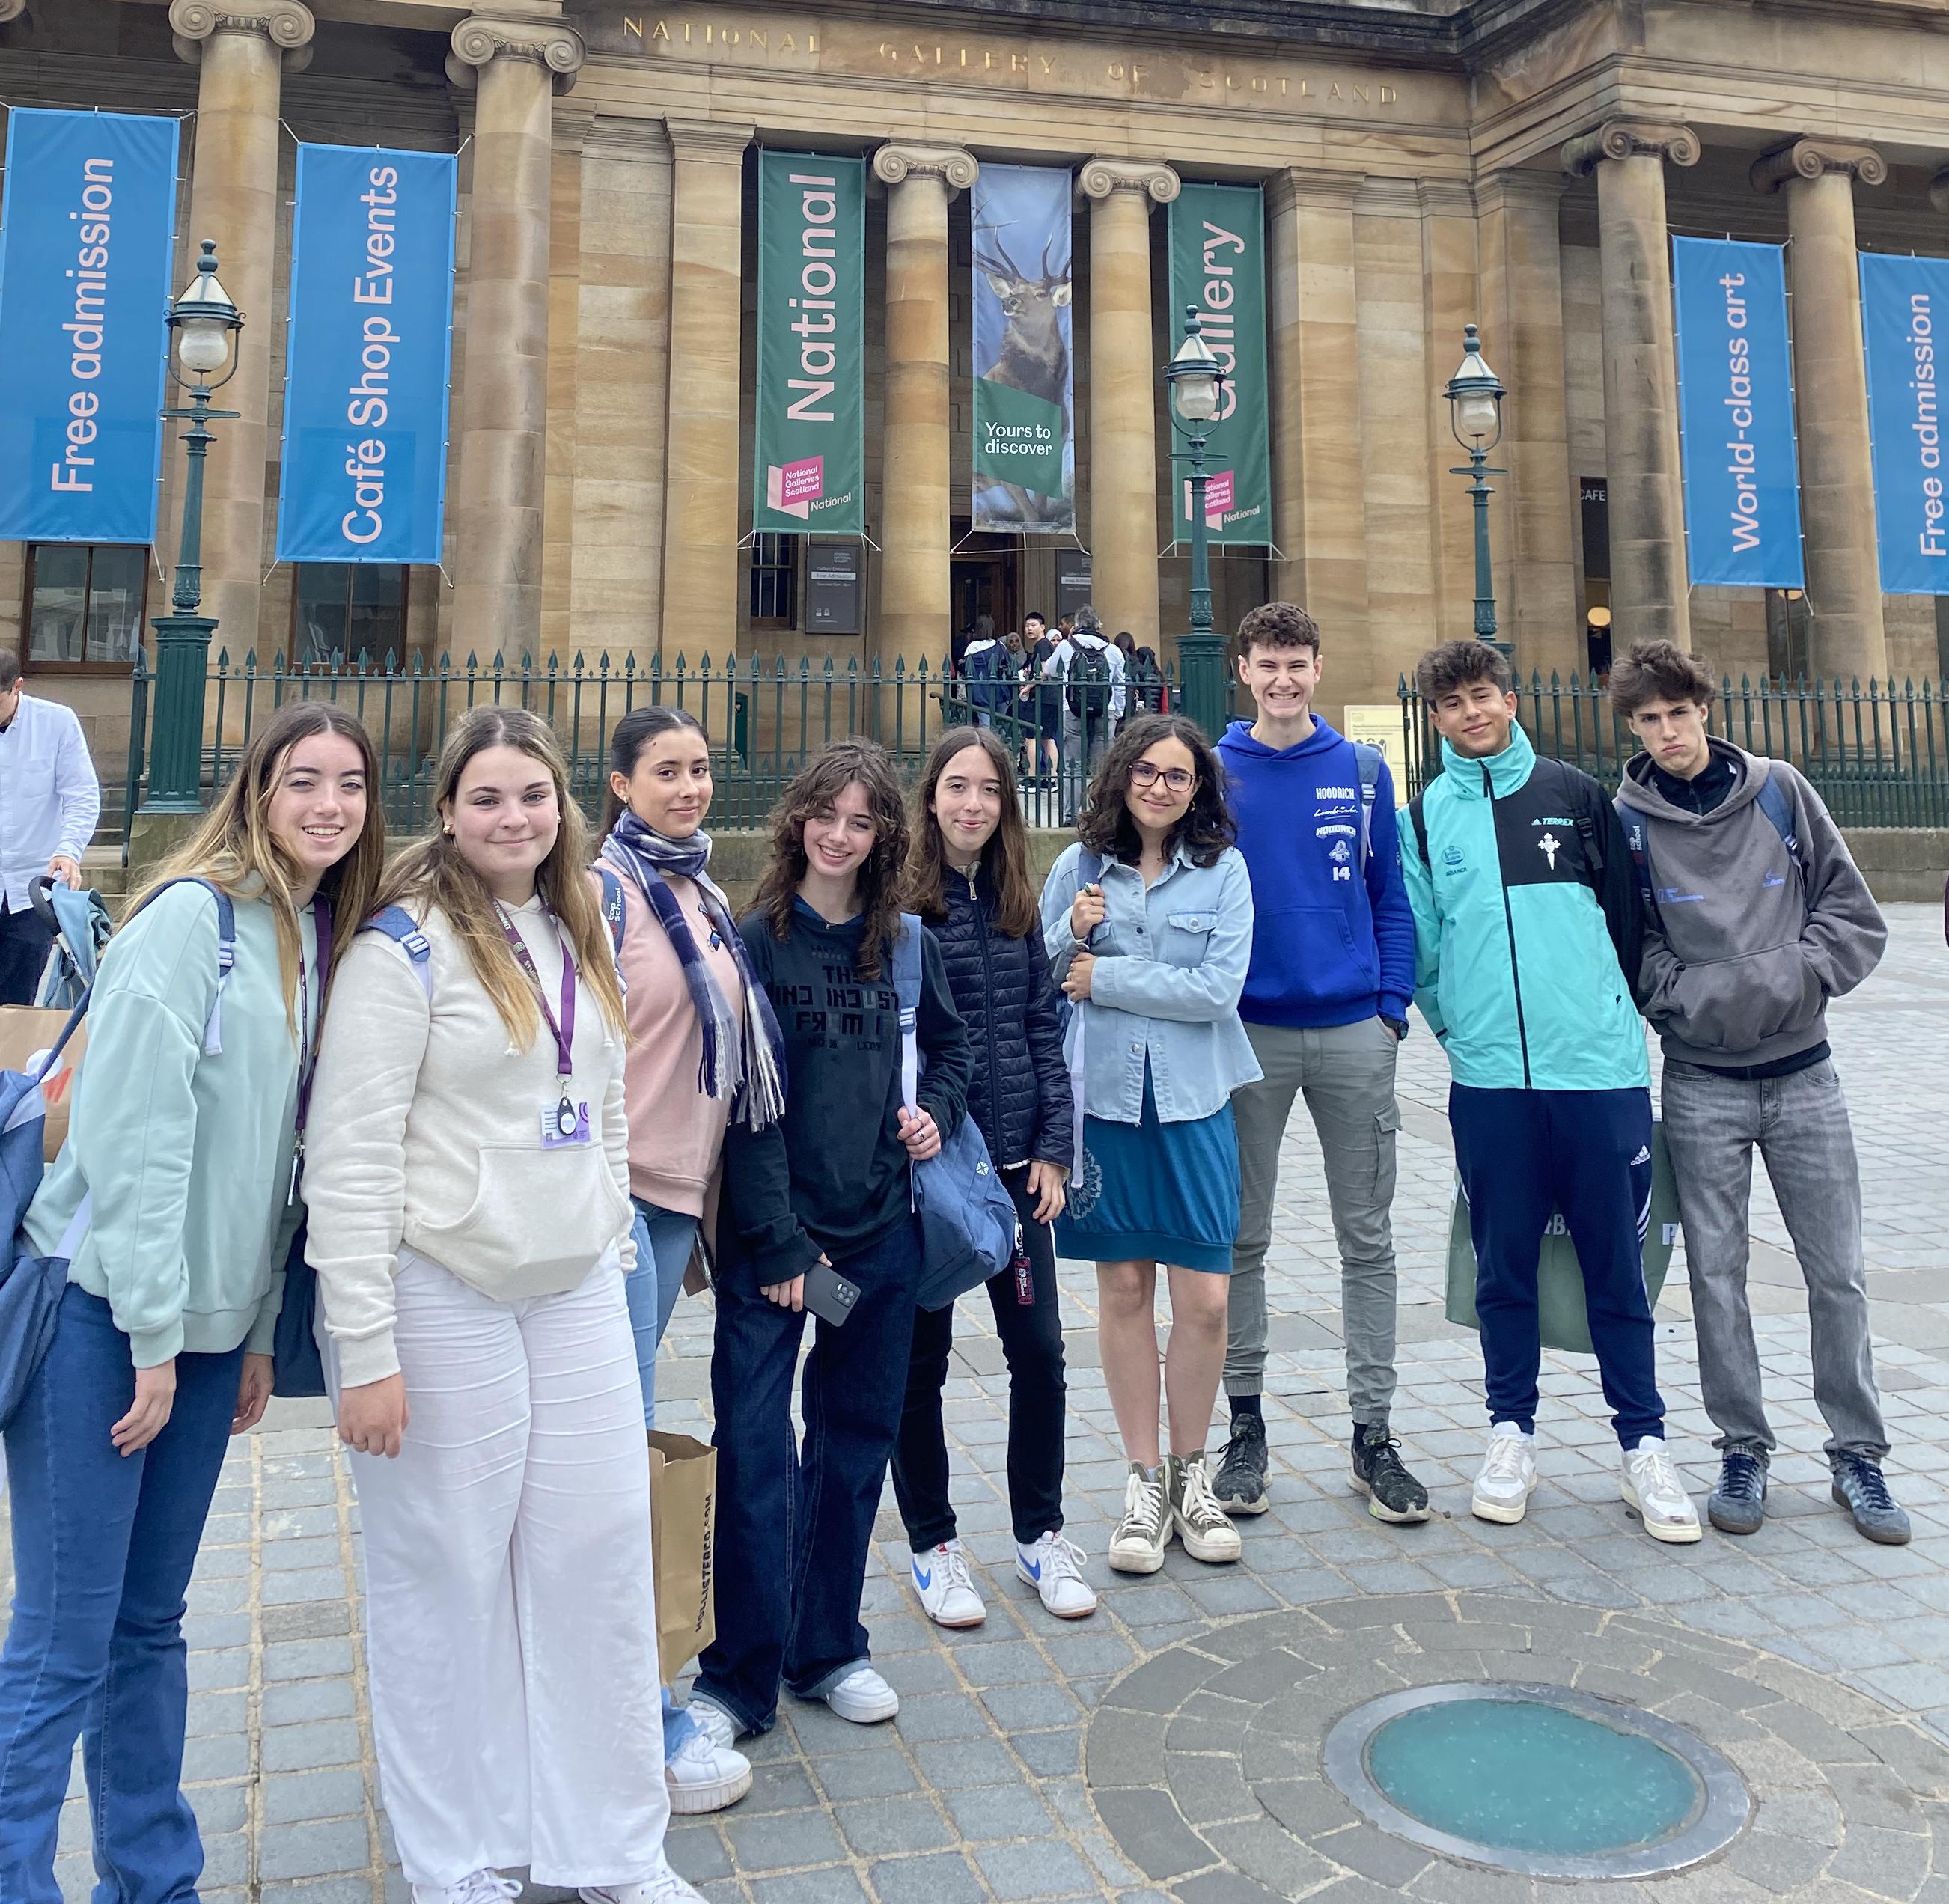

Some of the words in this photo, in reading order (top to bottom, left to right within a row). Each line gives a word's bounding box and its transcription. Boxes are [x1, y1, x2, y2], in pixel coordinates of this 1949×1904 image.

[623, 16, 820, 54] NATIONAL
[879, 42, 1055, 75] GALLERY
[1108, 61, 1148, 82] OF
[1199, 73, 1397, 104] SCOTLAND
[353, 166, 398, 305] Events
[62, 158, 114, 379] admission
[787, 174, 837, 421] National
[1719, 272, 1748, 329] art
[348, 316, 401, 427] Shop
[1906, 293, 1940, 469] admission
[985, 421, 1033, 438] Yours
[1035, 424, 1052, 439] to
[51, 391, 99, 492] Free
[985, 439, 1053, 456] discover
[1724, 338, 1760, 552] World-class
[785, 465, 818, 480] National
[785, 475, 820, 489] Galleries
[341, 441, 387, 544] Café
[784, 482, 820, 498] Scotland
[1204, 489, 1231, 501] alleries
[1205, 479, 1230, 492] ational
[811, 492, 852, 512] National
[1204, 495, 1231, 509] cotland
[1224, 504, 1260, 523] National
[1919, 477, 1947, 557] Free
[1315, 787, 1355, 800] HOODRICH
[1543, 817, 1574, 826] TERREX
[1332, 867, 1351, 881] 14
[608, 902, 616, 921] top
[822, 965, 864, 986] TH
[695, 1493, 712, 1633] HOLLISTERCO.COM
